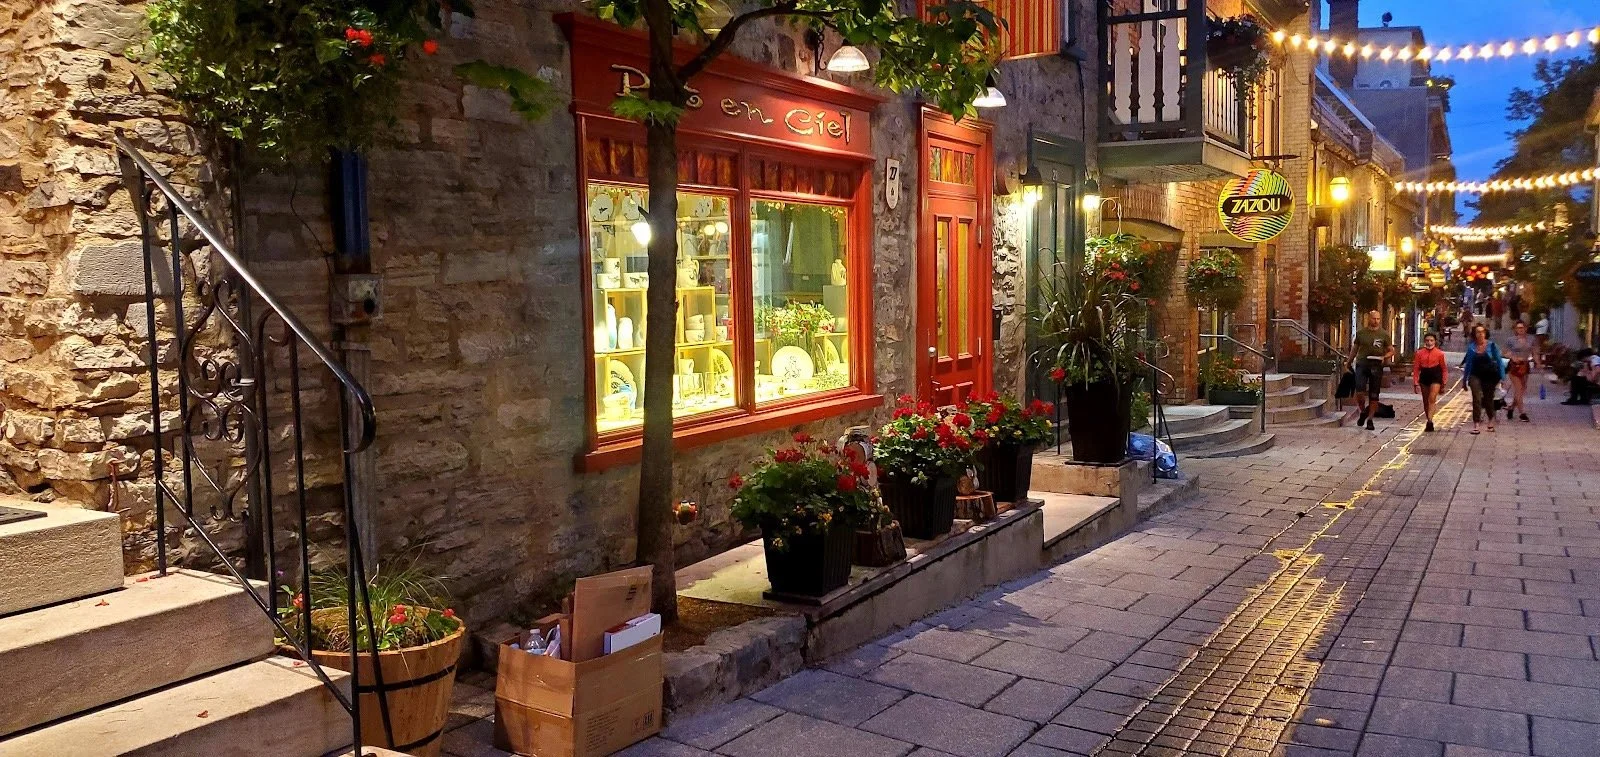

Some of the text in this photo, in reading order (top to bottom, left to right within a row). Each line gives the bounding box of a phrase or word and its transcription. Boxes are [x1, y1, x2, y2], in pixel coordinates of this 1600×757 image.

[720, 98, 774, 124] en
[784, 110, 852, 145] Ciel
[1230, 197, 1281, 214] ZAZOU
